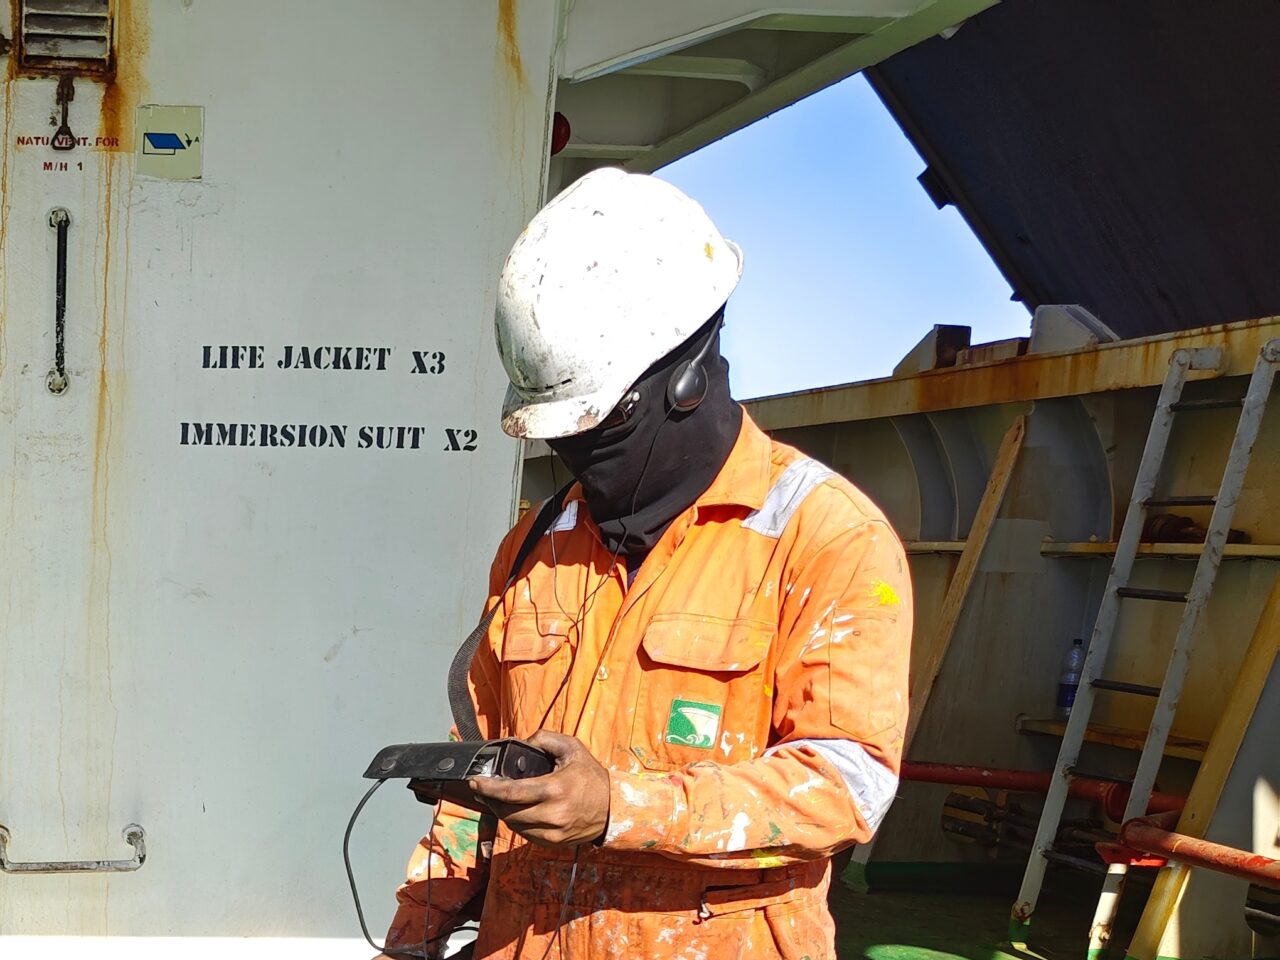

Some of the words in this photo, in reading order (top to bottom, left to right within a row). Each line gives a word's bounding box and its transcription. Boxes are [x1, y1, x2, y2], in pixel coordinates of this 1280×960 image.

[95, 137, 119, 147] FOR
[77, 162, 83, 171] 1
[201, 345, 265, 369] LIFE
[277, 346, 391, 370] JACKET
[410, 351, 446, 374] X3
[179, 422, 348, 448] IMMERSION
[357, 425, 425, 450] SUIT
[443, 428, 478, 452] X2
